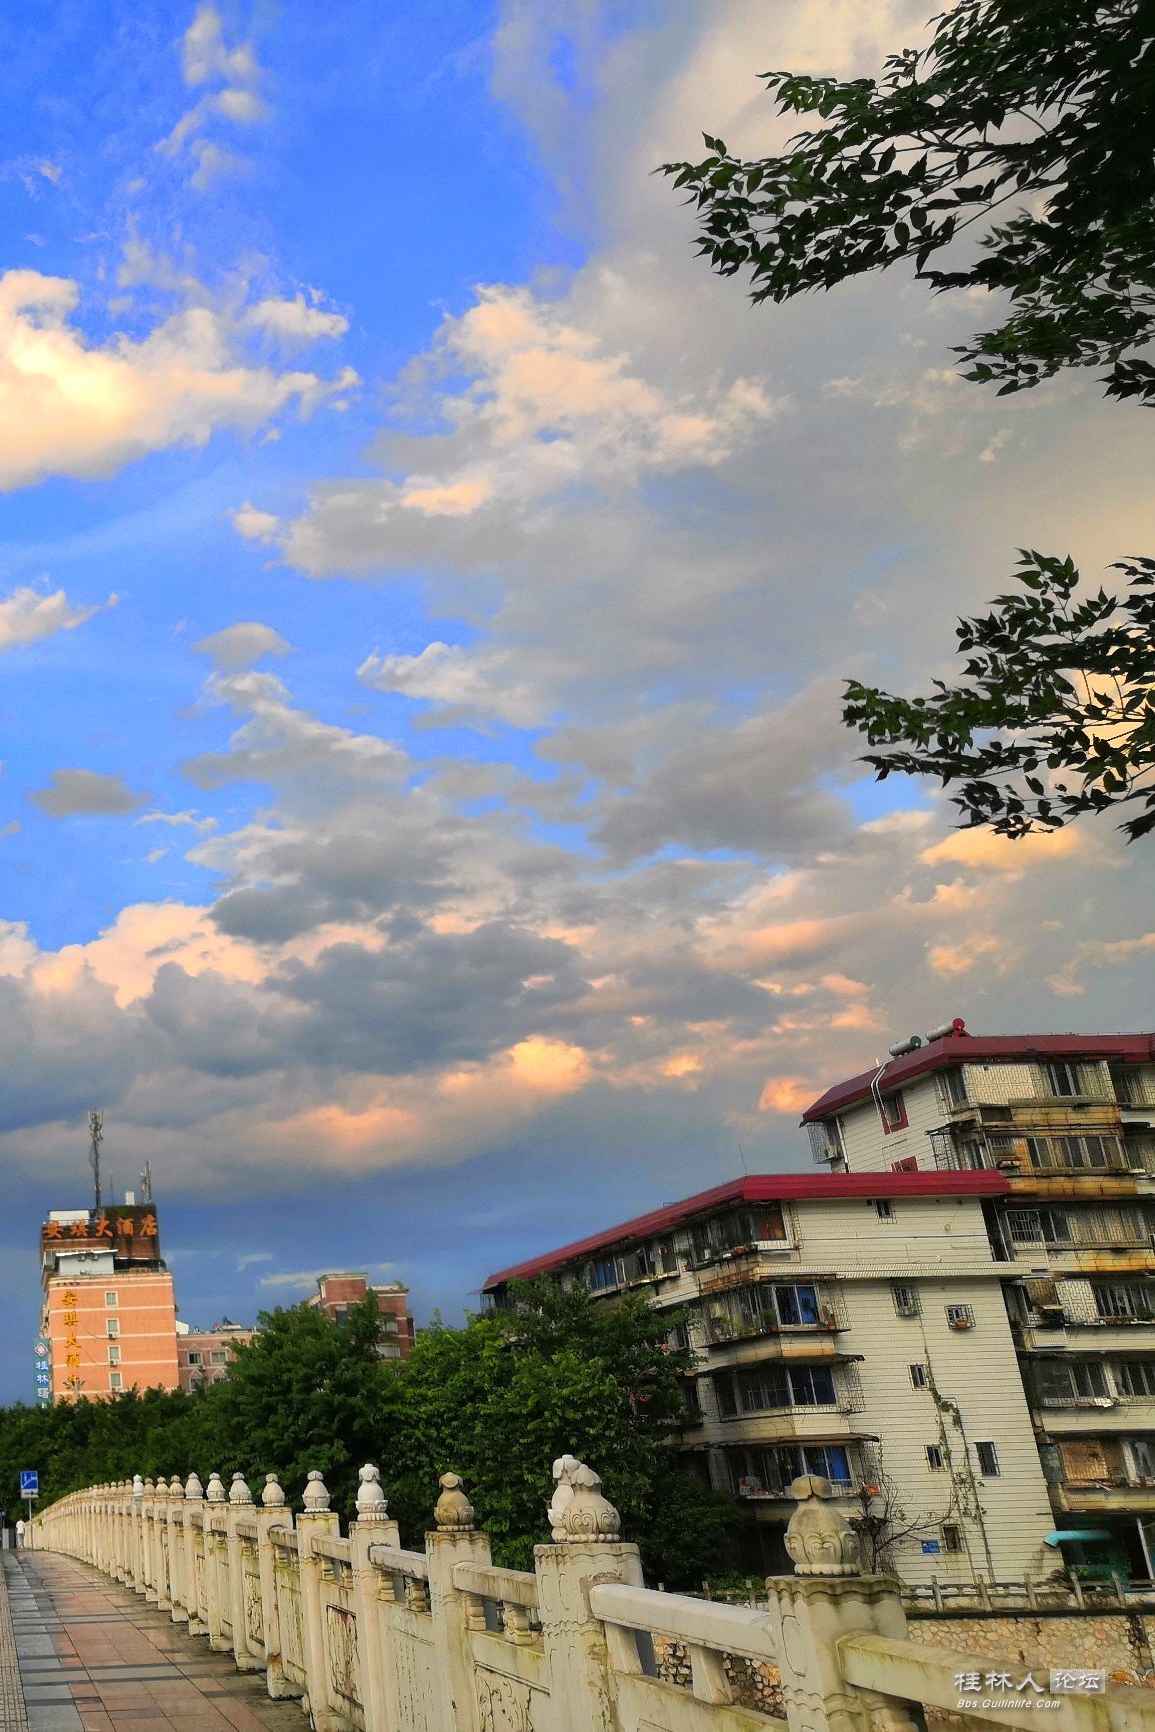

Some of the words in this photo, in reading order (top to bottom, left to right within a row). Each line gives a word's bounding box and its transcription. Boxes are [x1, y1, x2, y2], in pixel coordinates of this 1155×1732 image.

[43, 1214, 158, 1239] 安琪大酒店
